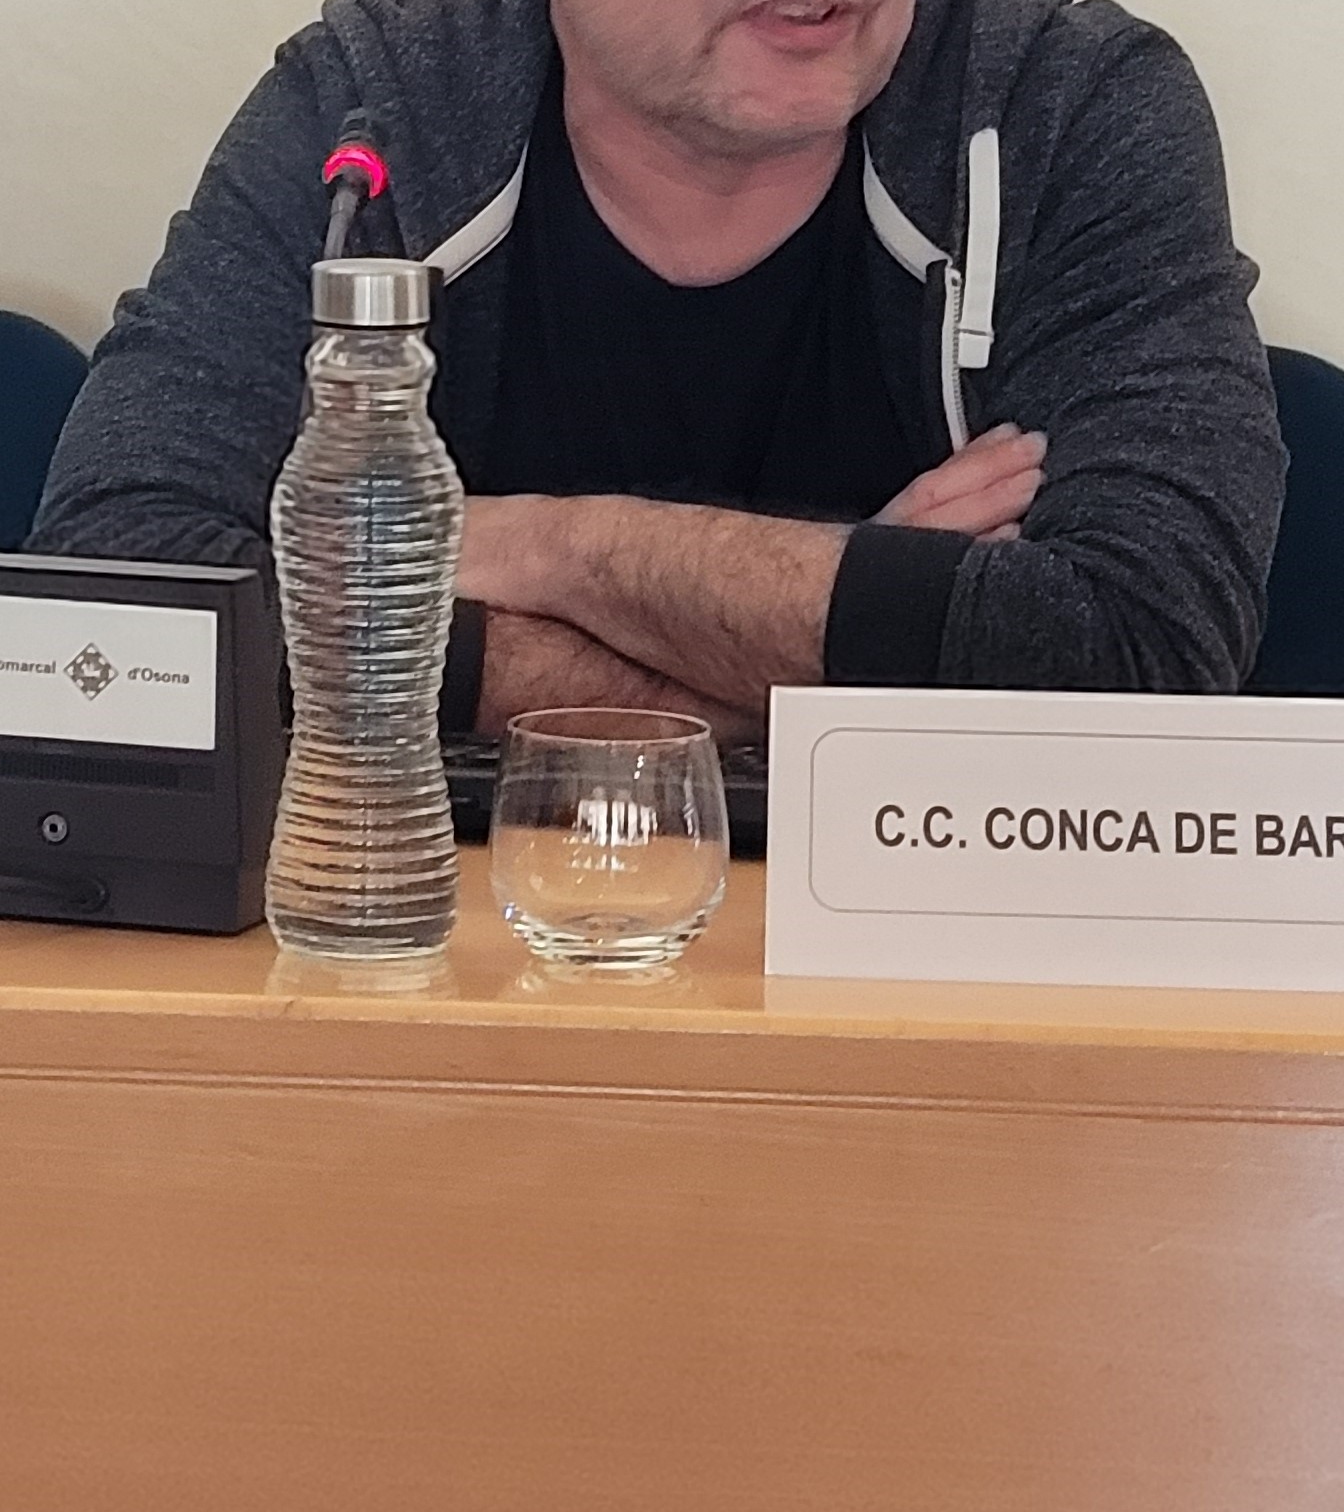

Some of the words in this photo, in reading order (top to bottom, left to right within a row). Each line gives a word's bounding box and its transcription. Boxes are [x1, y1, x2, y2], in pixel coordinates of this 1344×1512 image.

[127, 667, 190, 685] d'Osona
[873, 804, 967, 849] C.C.
[984, 806, 1161, 854] CONCA
[1174, 811, 1238, 855] DE
